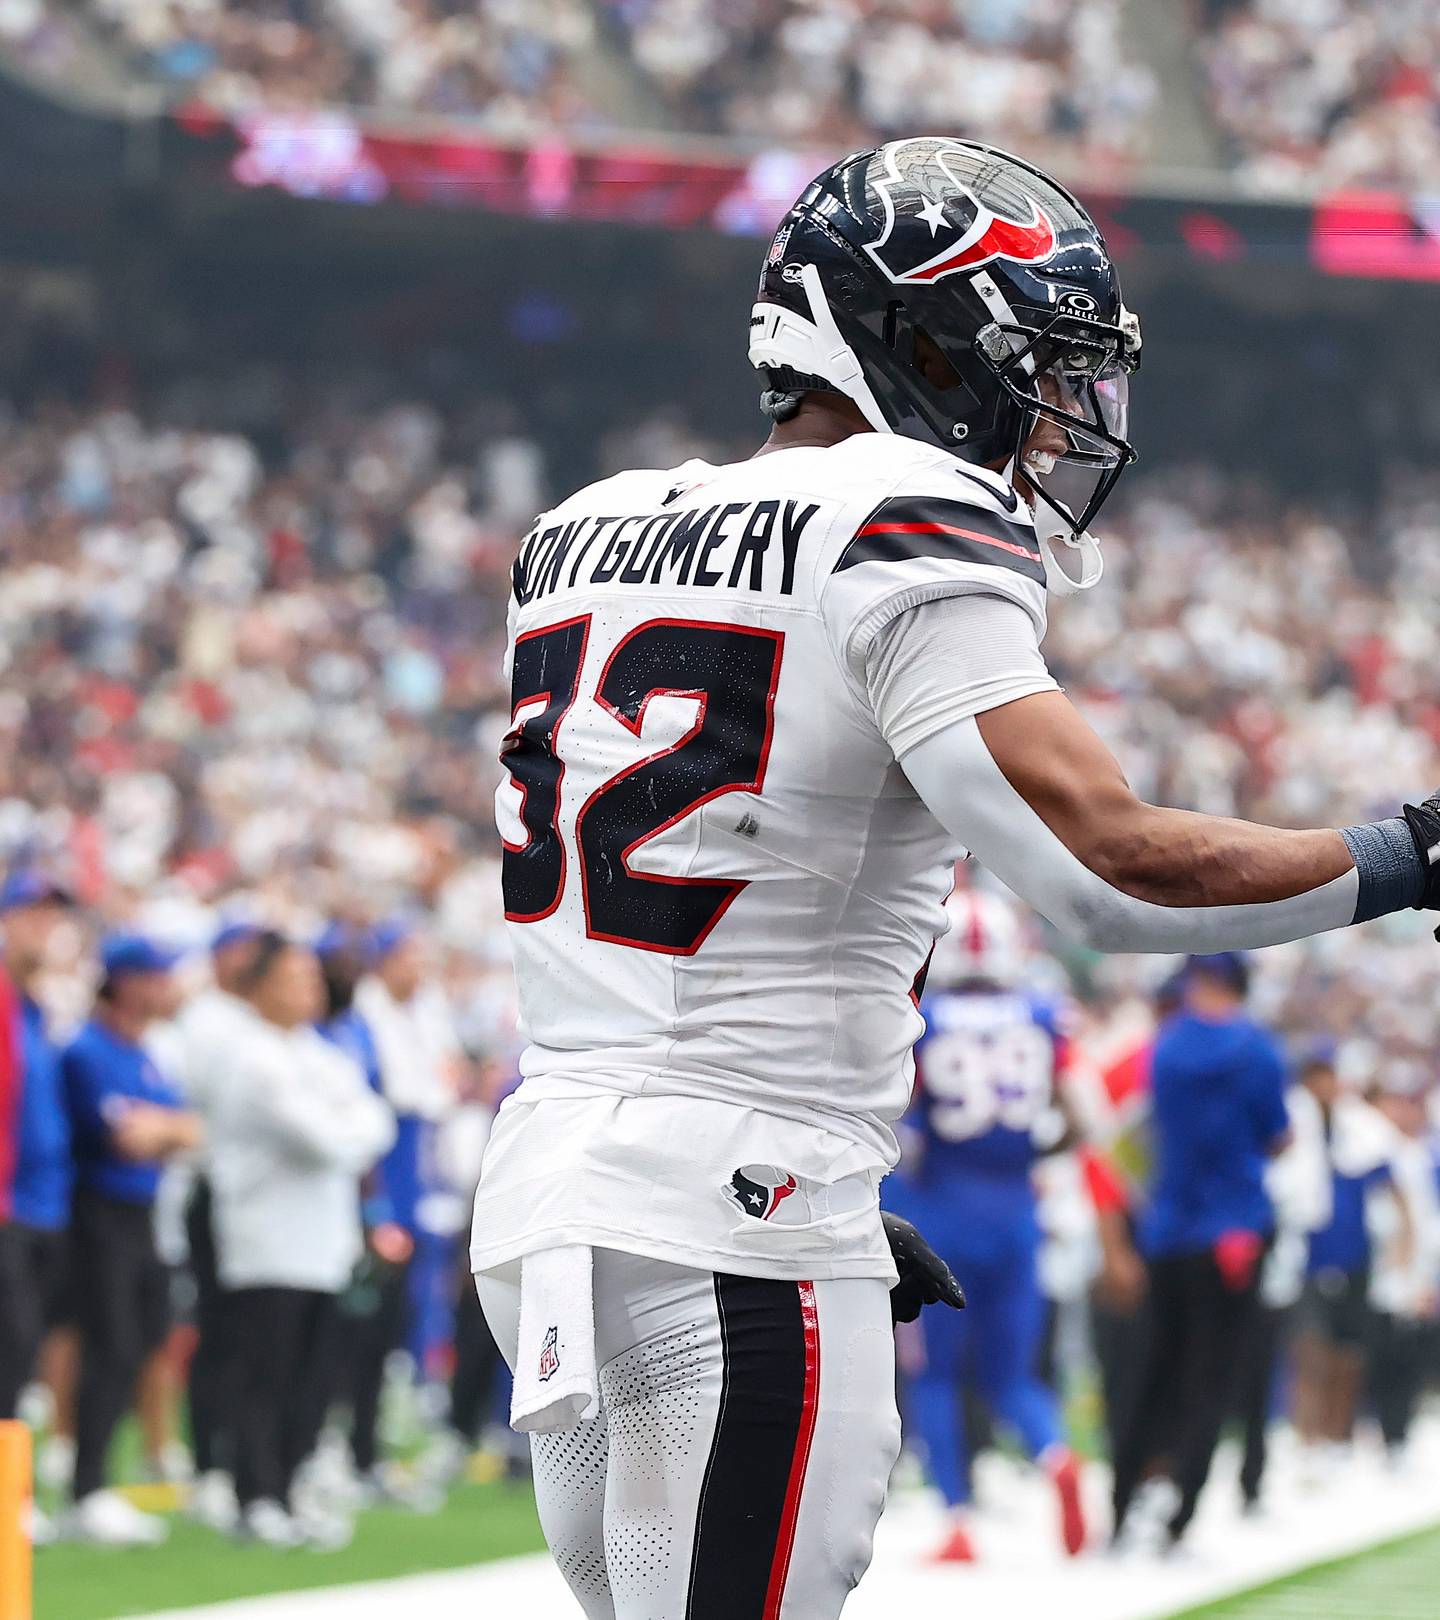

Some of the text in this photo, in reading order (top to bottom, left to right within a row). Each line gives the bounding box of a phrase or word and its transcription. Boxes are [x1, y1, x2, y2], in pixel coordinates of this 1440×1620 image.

[1059, 305, 1099, 321] OAKLEY
[499, 612, 786, 957] 32
[921, 1024, 1056, 1142] 99
[540, 1348, 555, 1375] NFL
